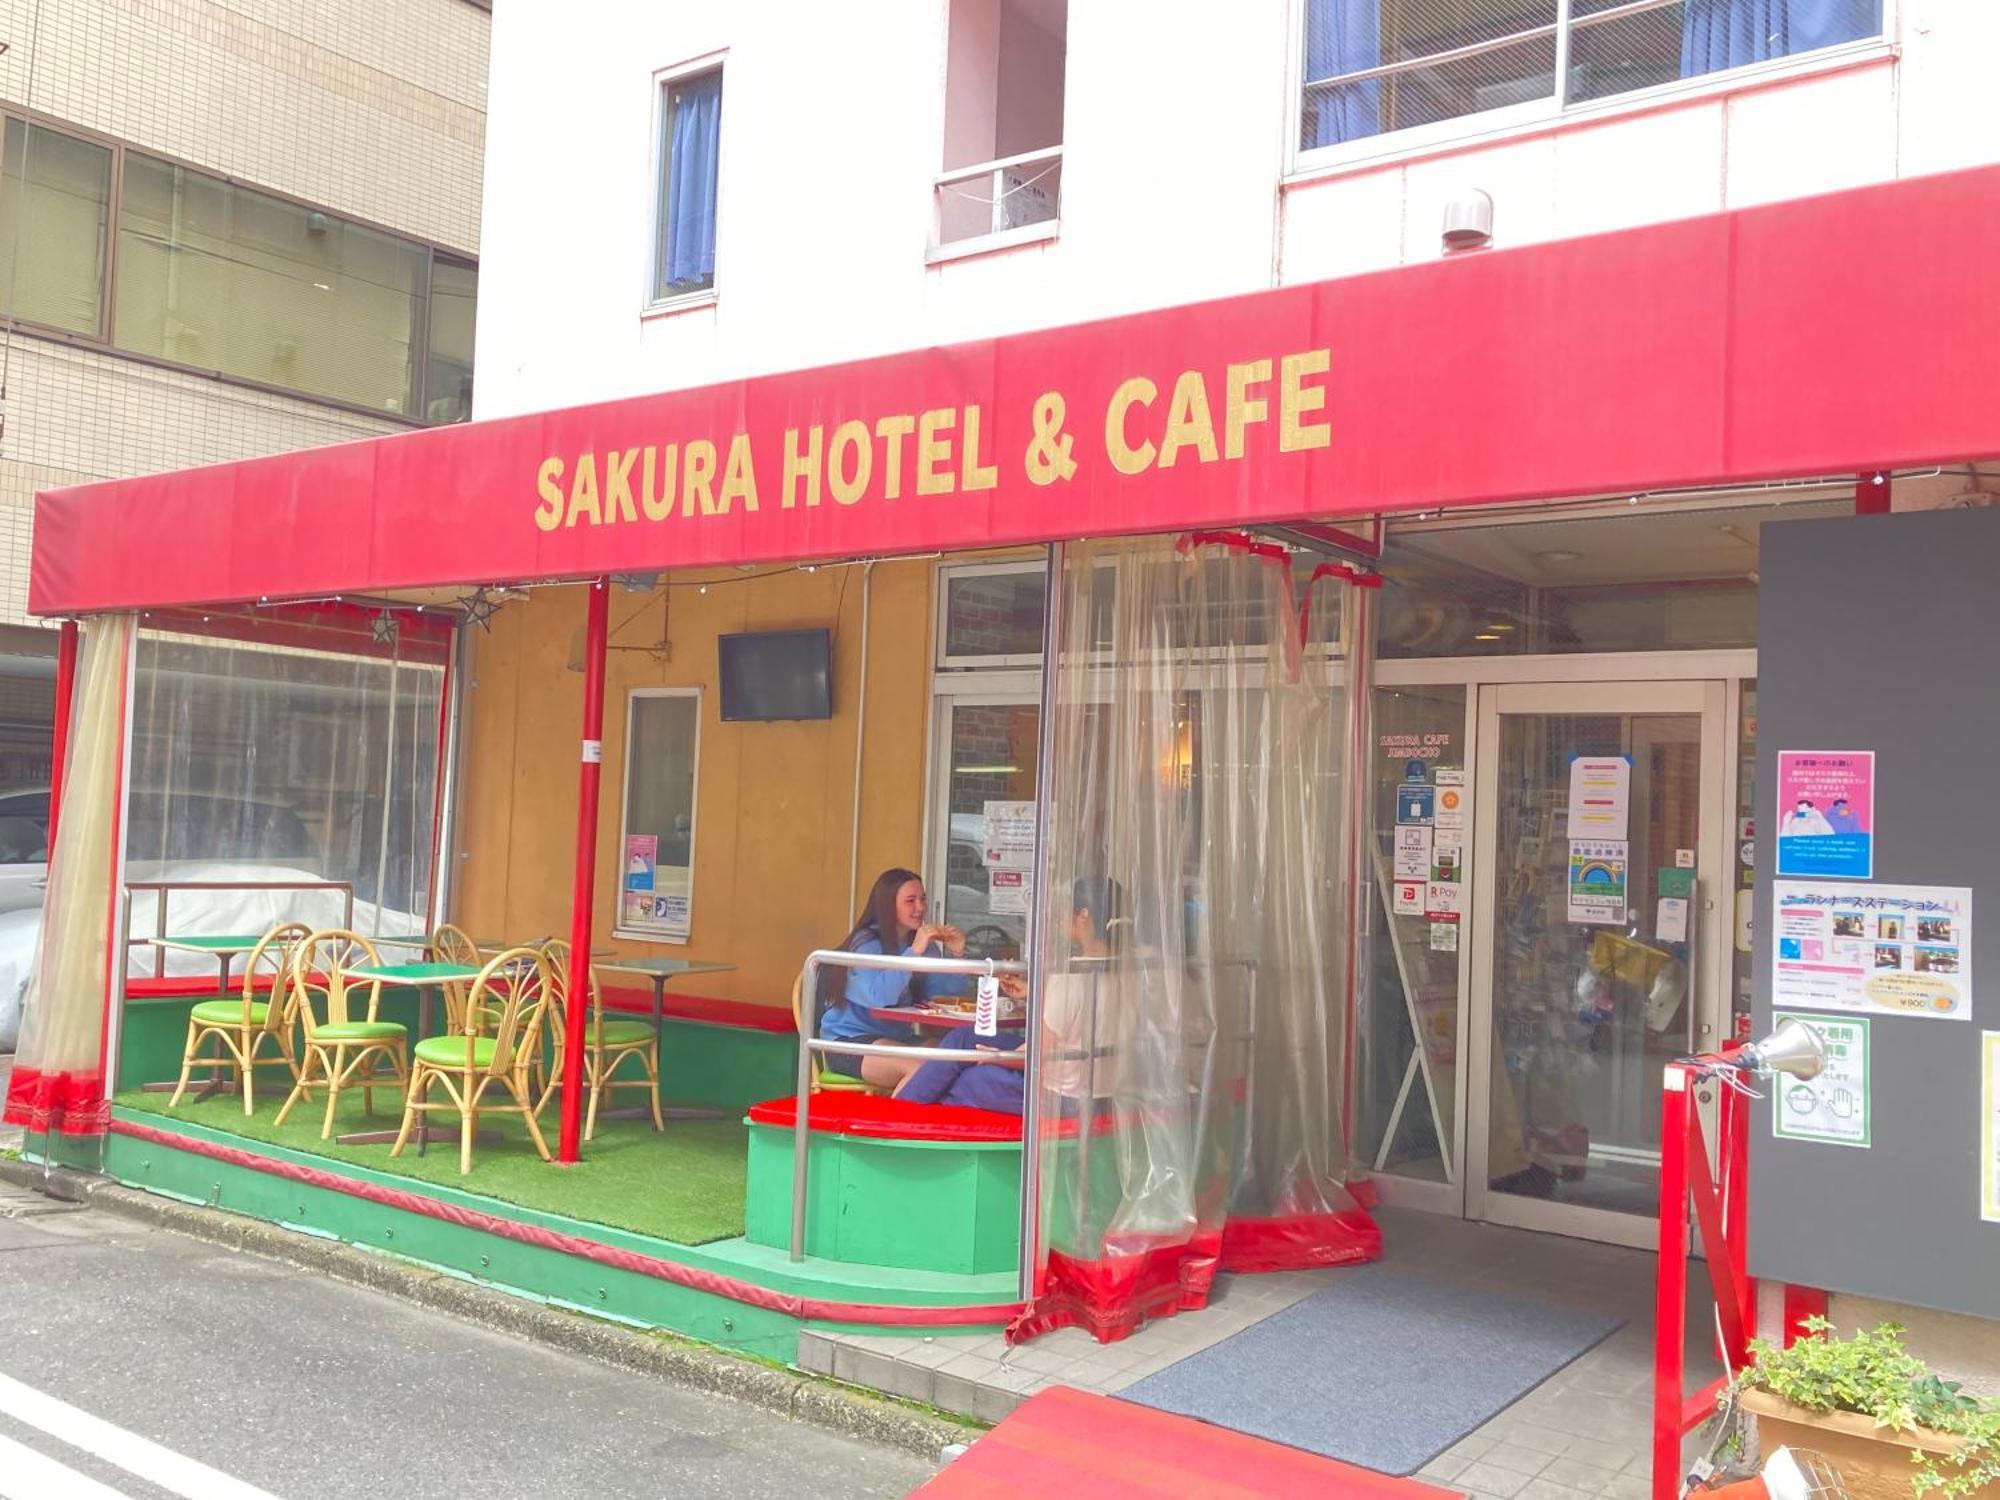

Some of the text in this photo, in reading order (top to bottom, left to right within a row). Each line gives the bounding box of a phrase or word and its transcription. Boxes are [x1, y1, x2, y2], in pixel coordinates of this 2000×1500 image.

[535, 348, 1332, 533] SAKURA HOTEL & CAFE
[1424, 734, 1450, 745] CAFE
[1805, 893, 1940, 912] ランナースステーション
